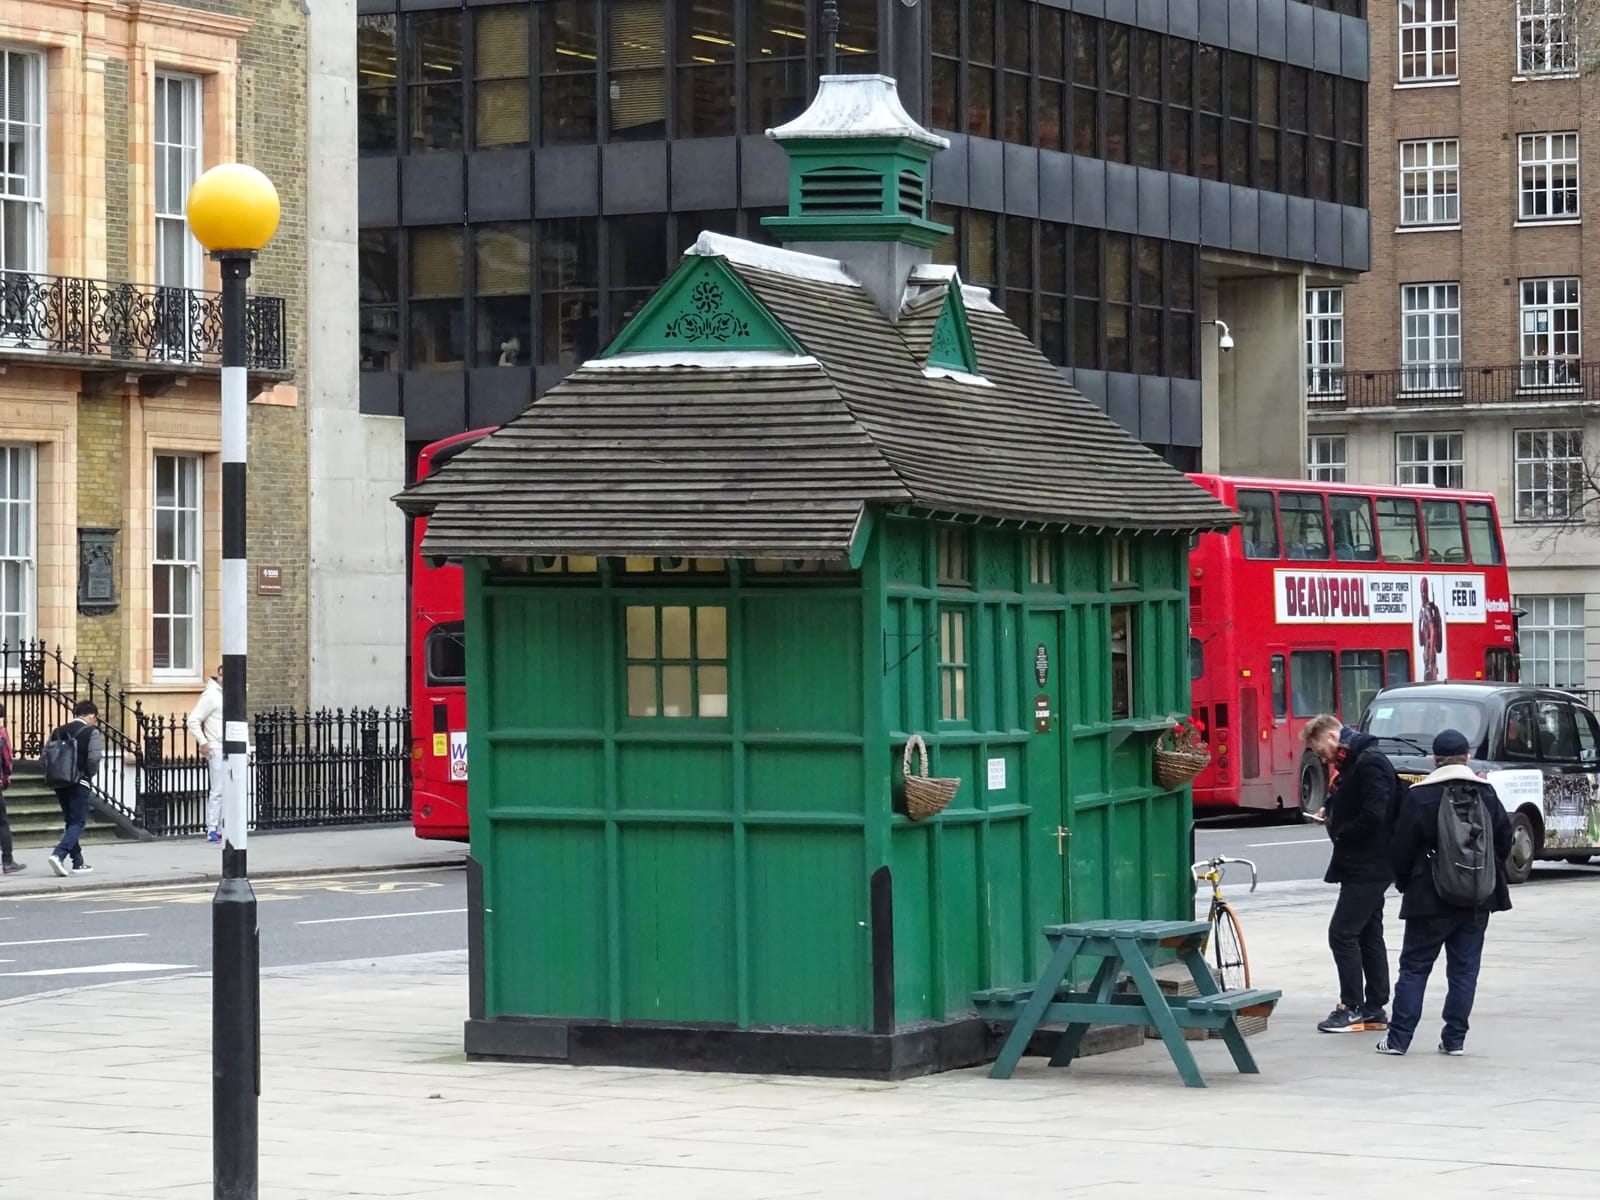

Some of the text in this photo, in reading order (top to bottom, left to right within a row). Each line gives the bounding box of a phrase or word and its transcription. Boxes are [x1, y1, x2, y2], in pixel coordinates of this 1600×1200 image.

[1382, 582, 1394, 591] GREAT
[1395, 582, 1409, 592] POWER
[1285, 576, 1370, 616] DEADPOOL
[1376, 593, 1403, 602] COMES GREAT
[1452, 589, 1476, 606] FEB 10
